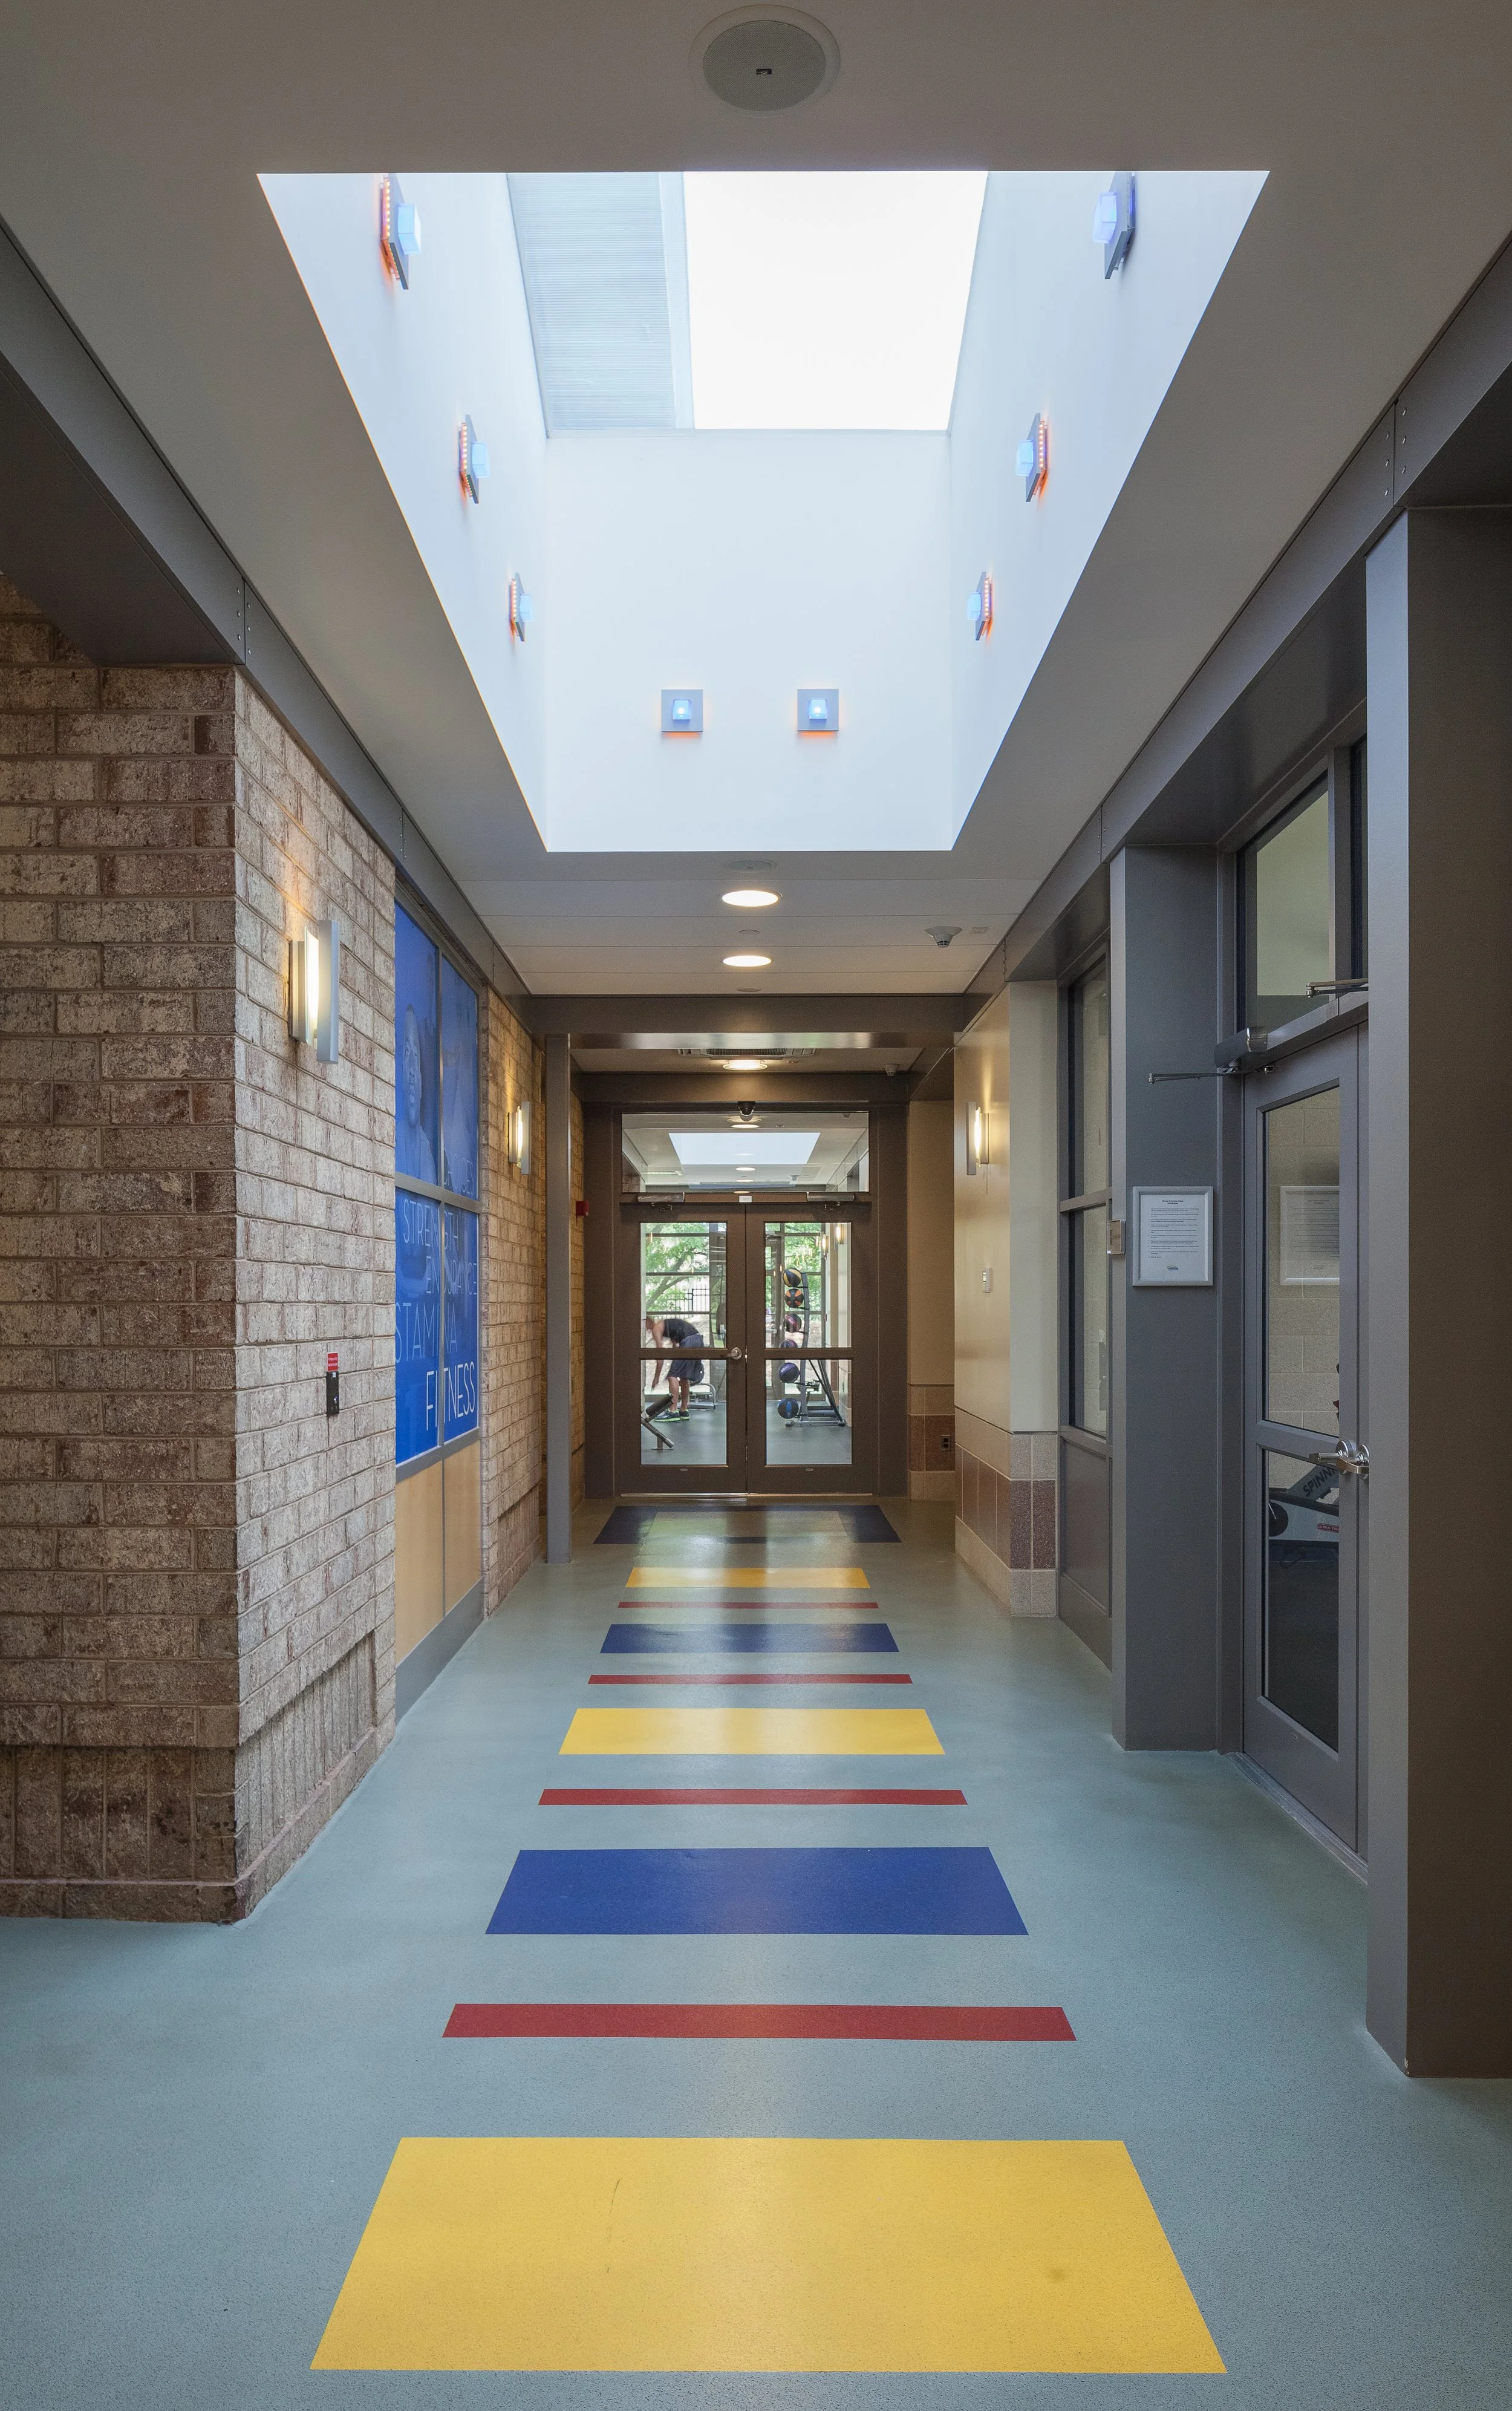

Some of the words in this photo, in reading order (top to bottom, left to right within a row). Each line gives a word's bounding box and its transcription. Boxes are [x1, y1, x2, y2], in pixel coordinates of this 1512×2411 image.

[403, 1198, 459, 1252] STRENGTH
[395, 1302, 457, 1365] STAMINA
[426, 1361, 475, 1431] FITNESS
[1303, 1468, 1335, 1497] SPINN
